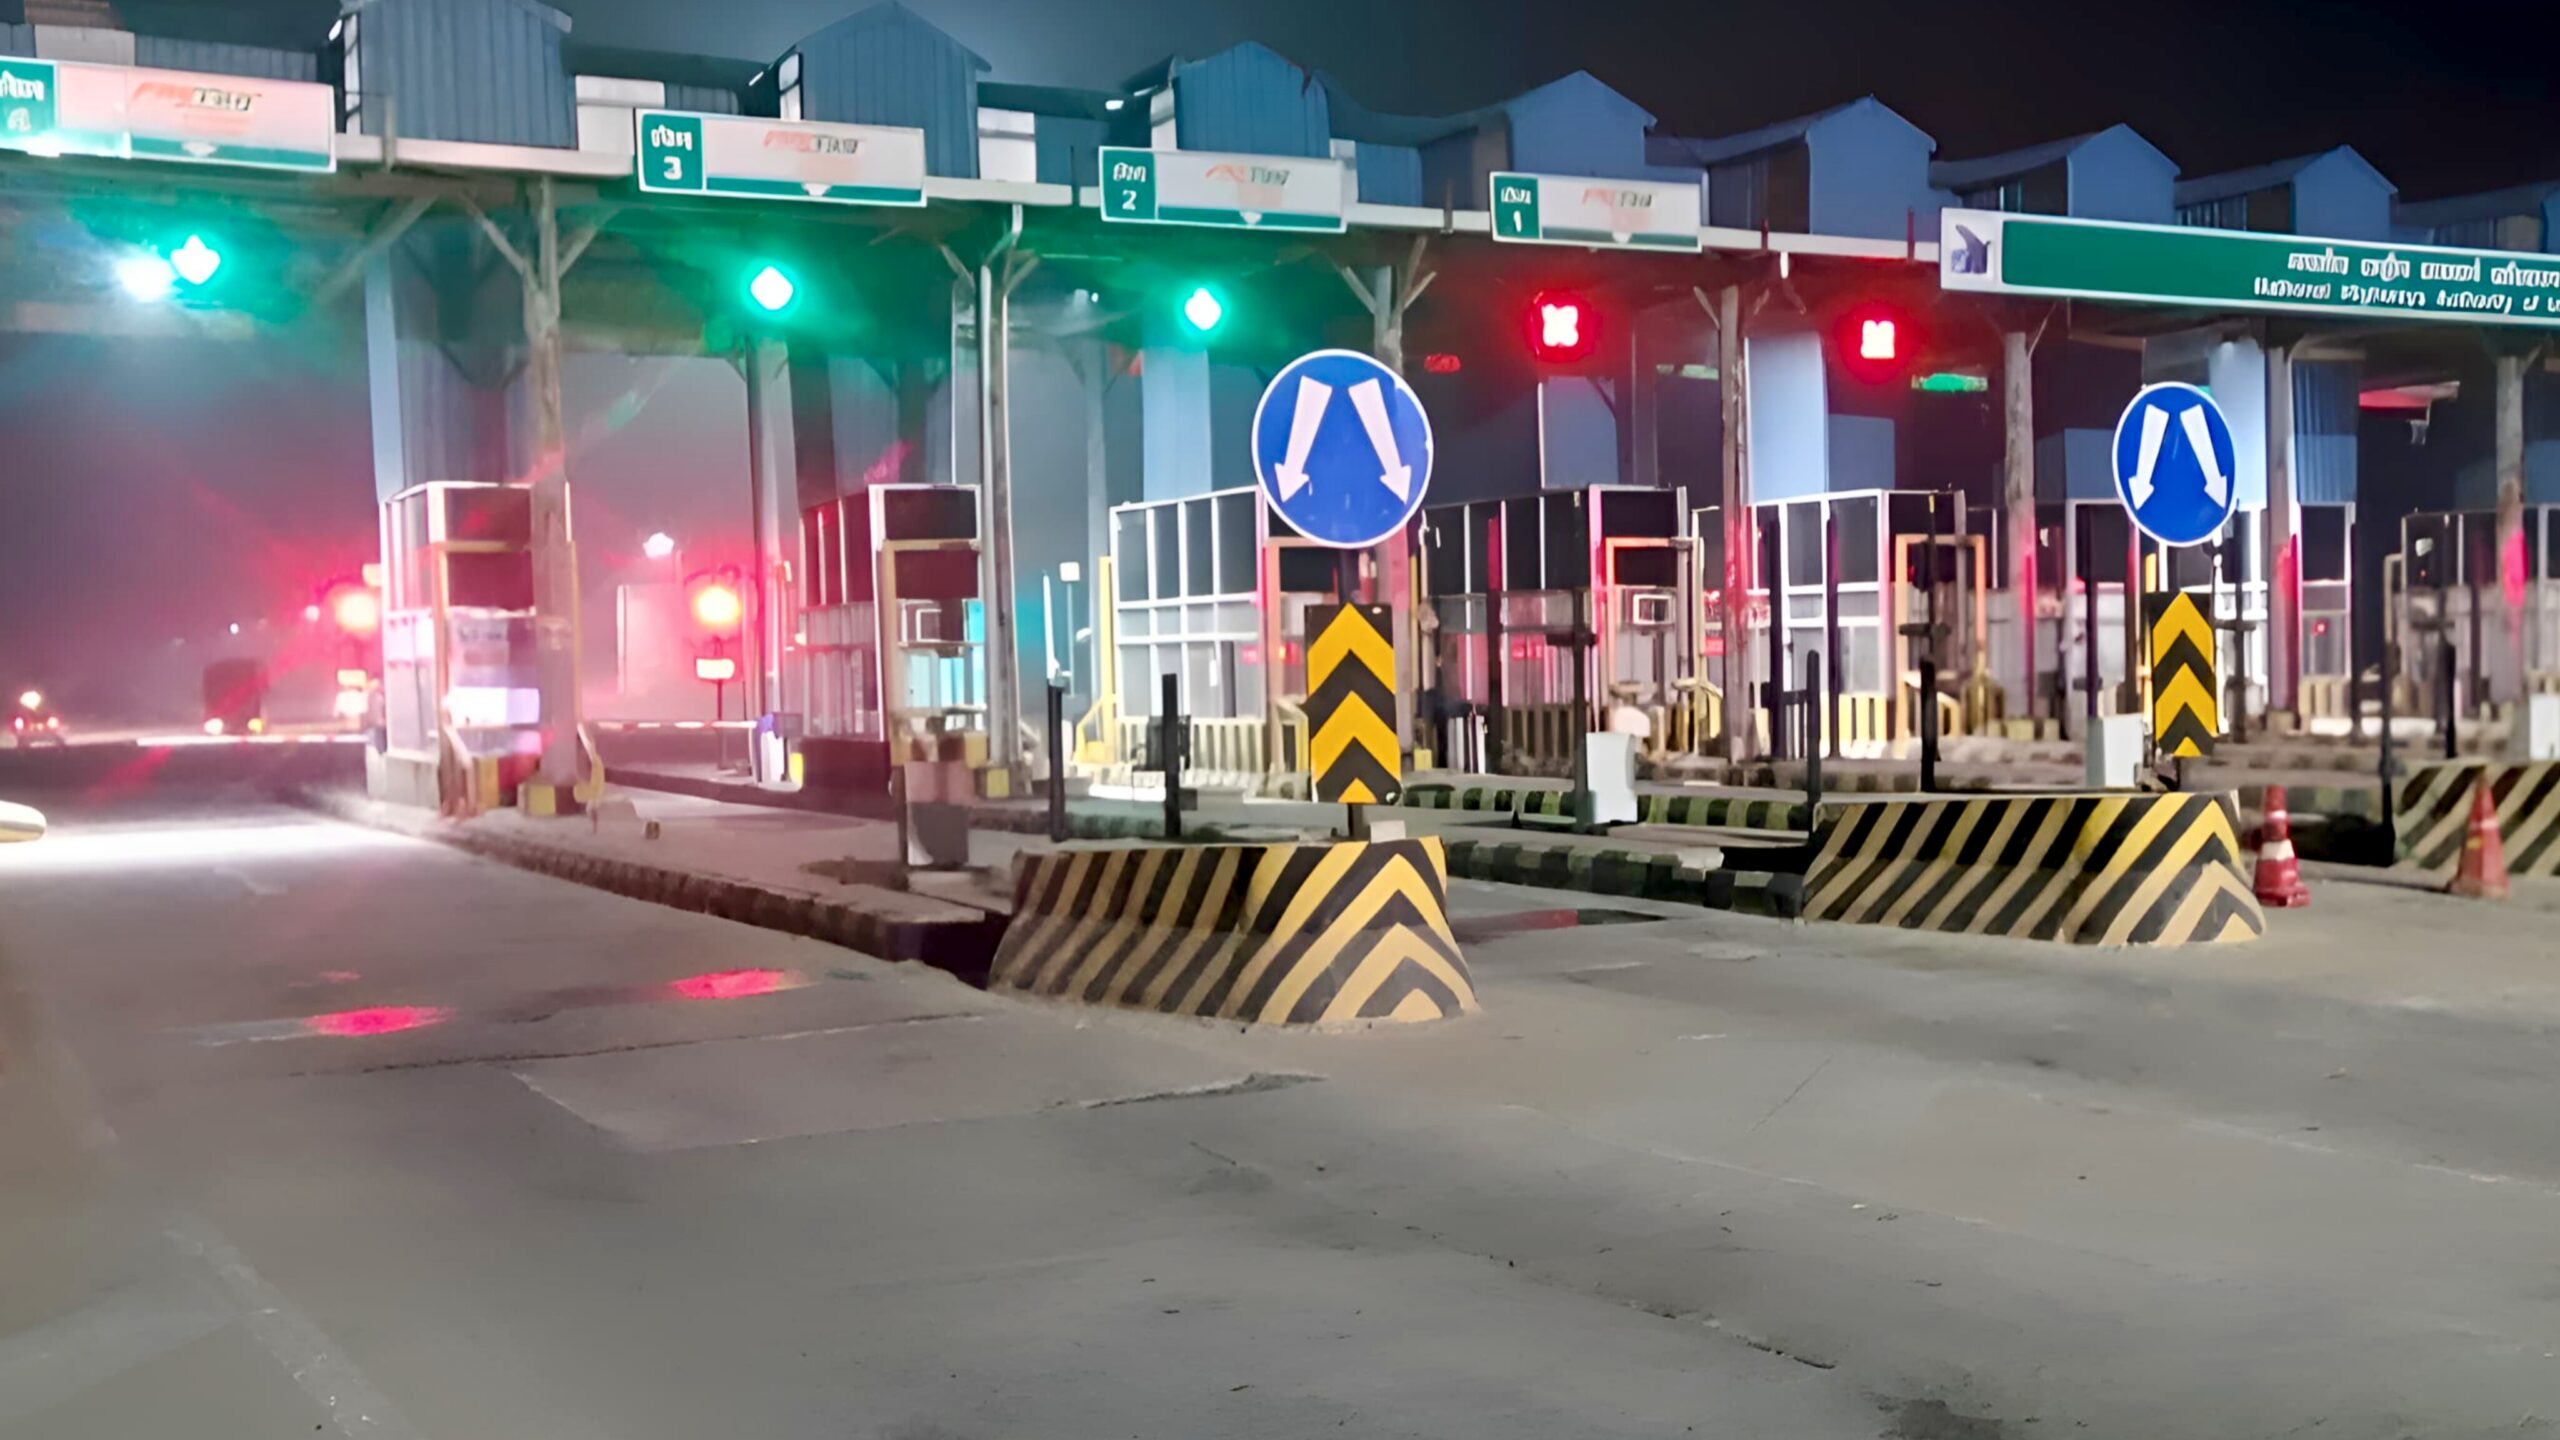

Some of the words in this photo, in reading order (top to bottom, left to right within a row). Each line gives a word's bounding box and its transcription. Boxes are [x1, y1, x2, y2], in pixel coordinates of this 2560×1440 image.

[664, 156, 682, 180] 3
[1122, 189, 1137, 211] 2
[1513, 211, 1522, 232] 1
